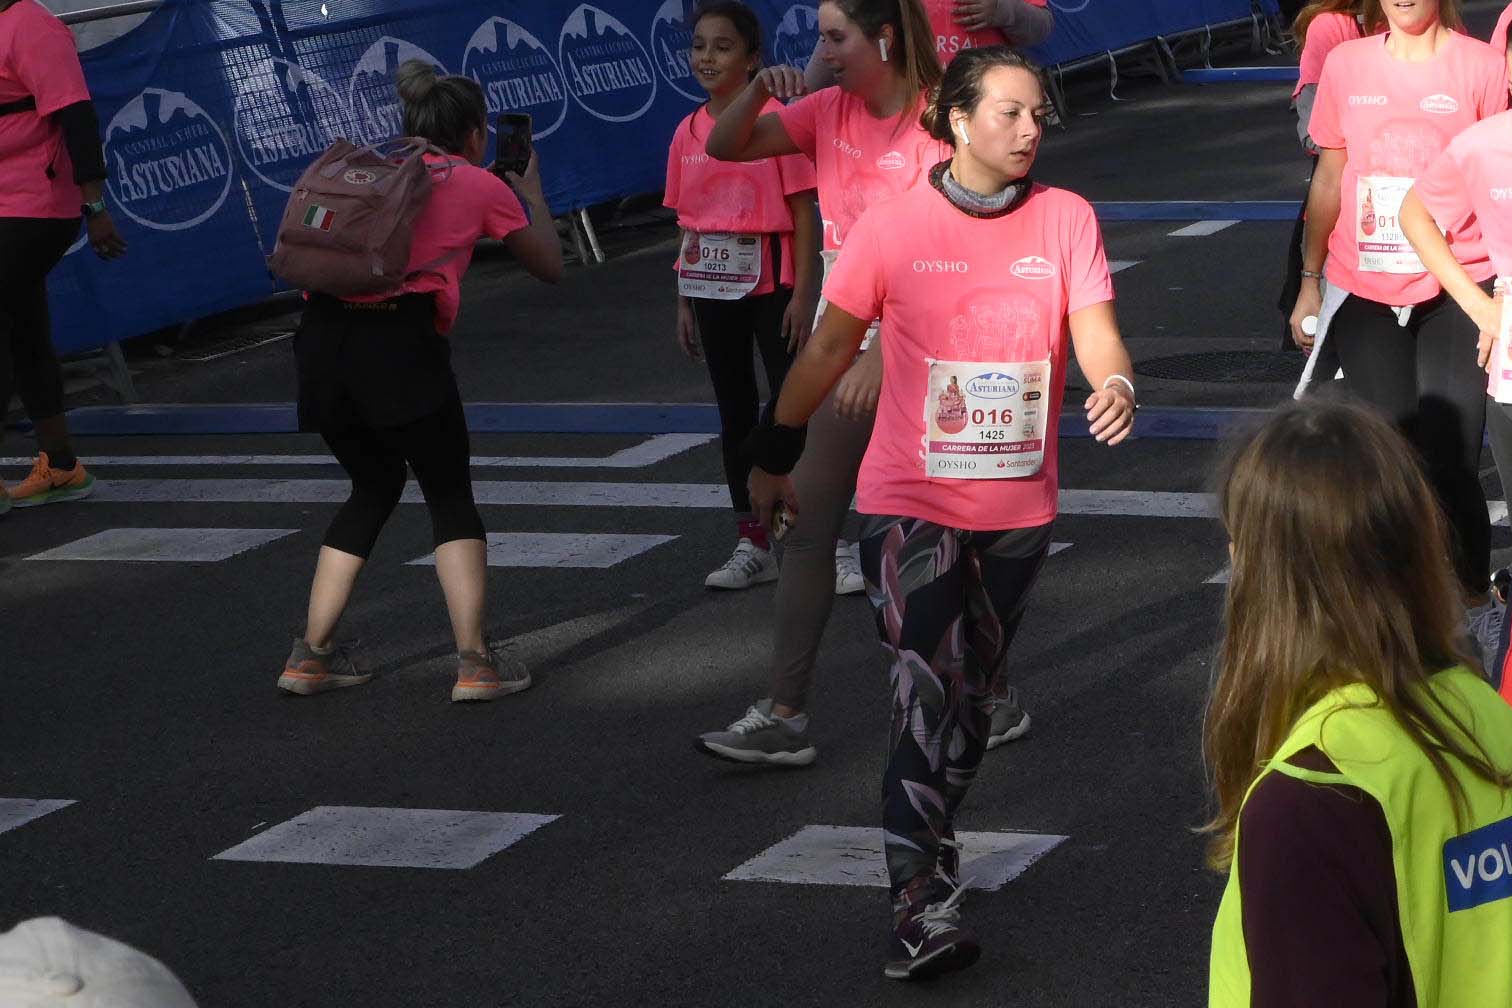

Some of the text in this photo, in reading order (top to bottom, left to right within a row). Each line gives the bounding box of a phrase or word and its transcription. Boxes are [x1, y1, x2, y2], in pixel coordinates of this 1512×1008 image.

[567, 52, 651, 97] ASTURIANA
[116, 143, 226, 203] ASTURIANA
[1379, 215, 1398, 227] 01
[702, 247, 729, 260] 016
[913, 260, 968, 273] OYSHO
[970, 382, 1016, 393] ASTURIANA
[971, 409, 1013, 425] 016
[980, 430, 1005, 440] 1425
[938, 460, 977, 470] OYSHO
[1007, 459, 1036, 468] Santander
